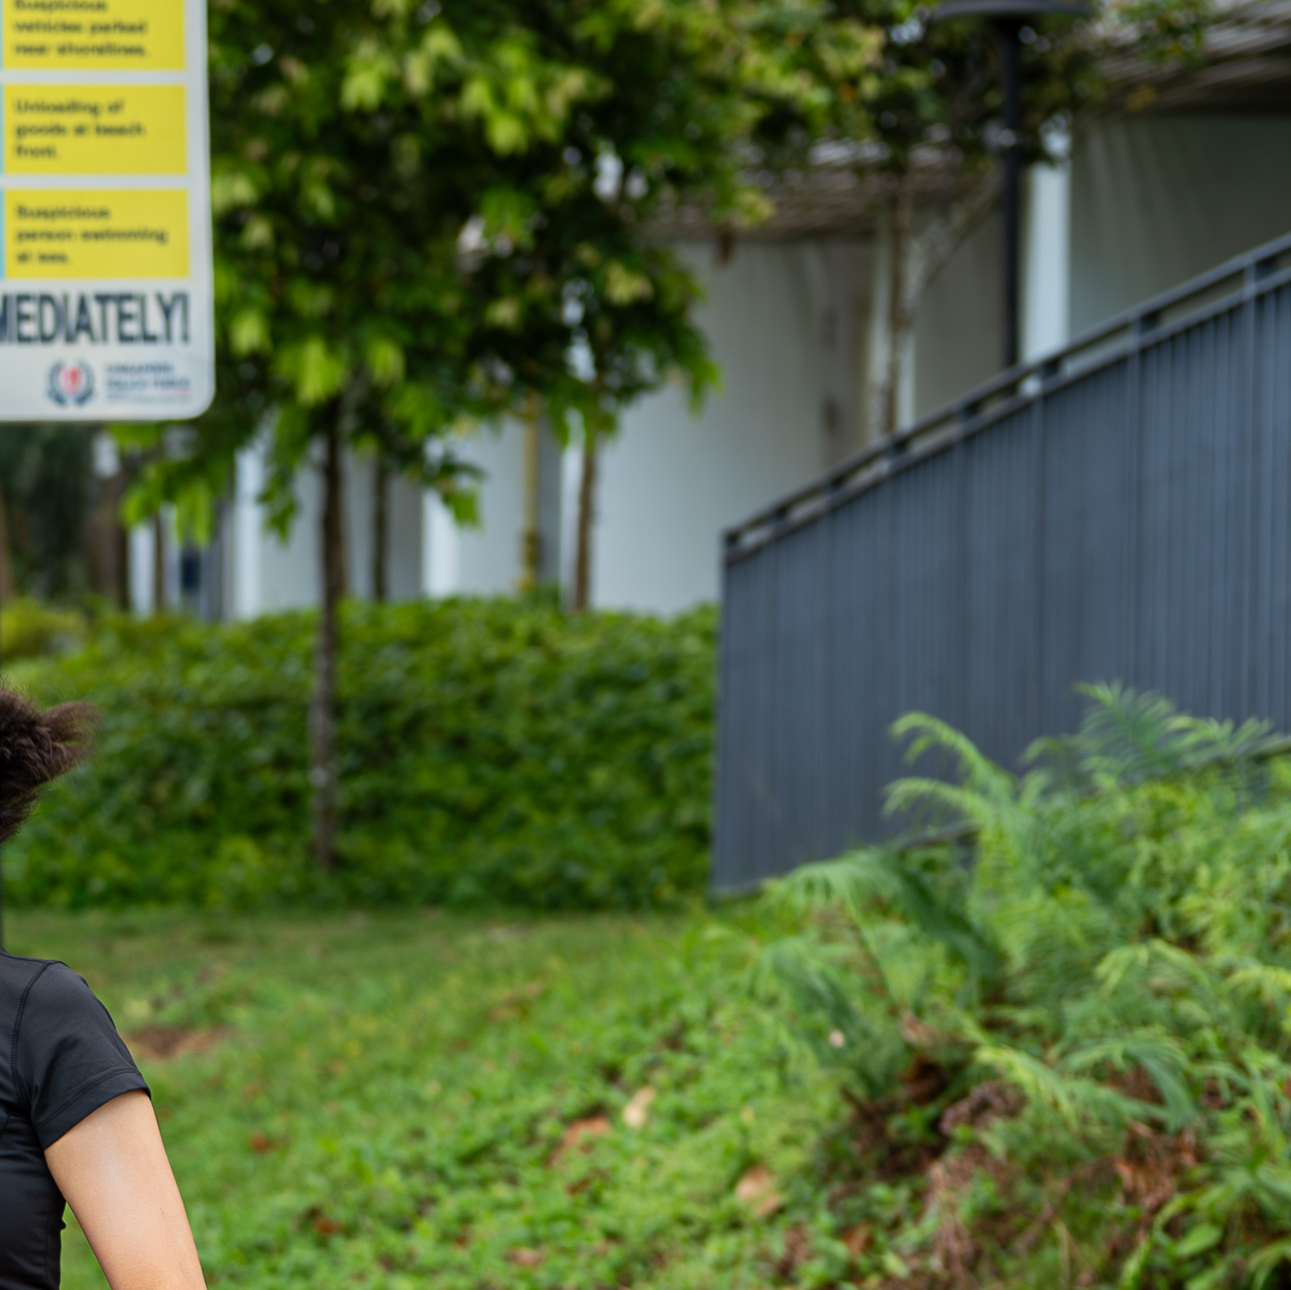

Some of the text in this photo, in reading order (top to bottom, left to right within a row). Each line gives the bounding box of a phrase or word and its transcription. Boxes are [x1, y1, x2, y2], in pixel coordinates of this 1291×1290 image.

[16, 98, 125, 116] Unloading of
[15, 122, 67, 139] goods
[74, 123, 90, 137] at
[16, 205, 111, 221] Suspicious
[81, 227, 169, 246] swimming
[17, 250, 33, 264] at
